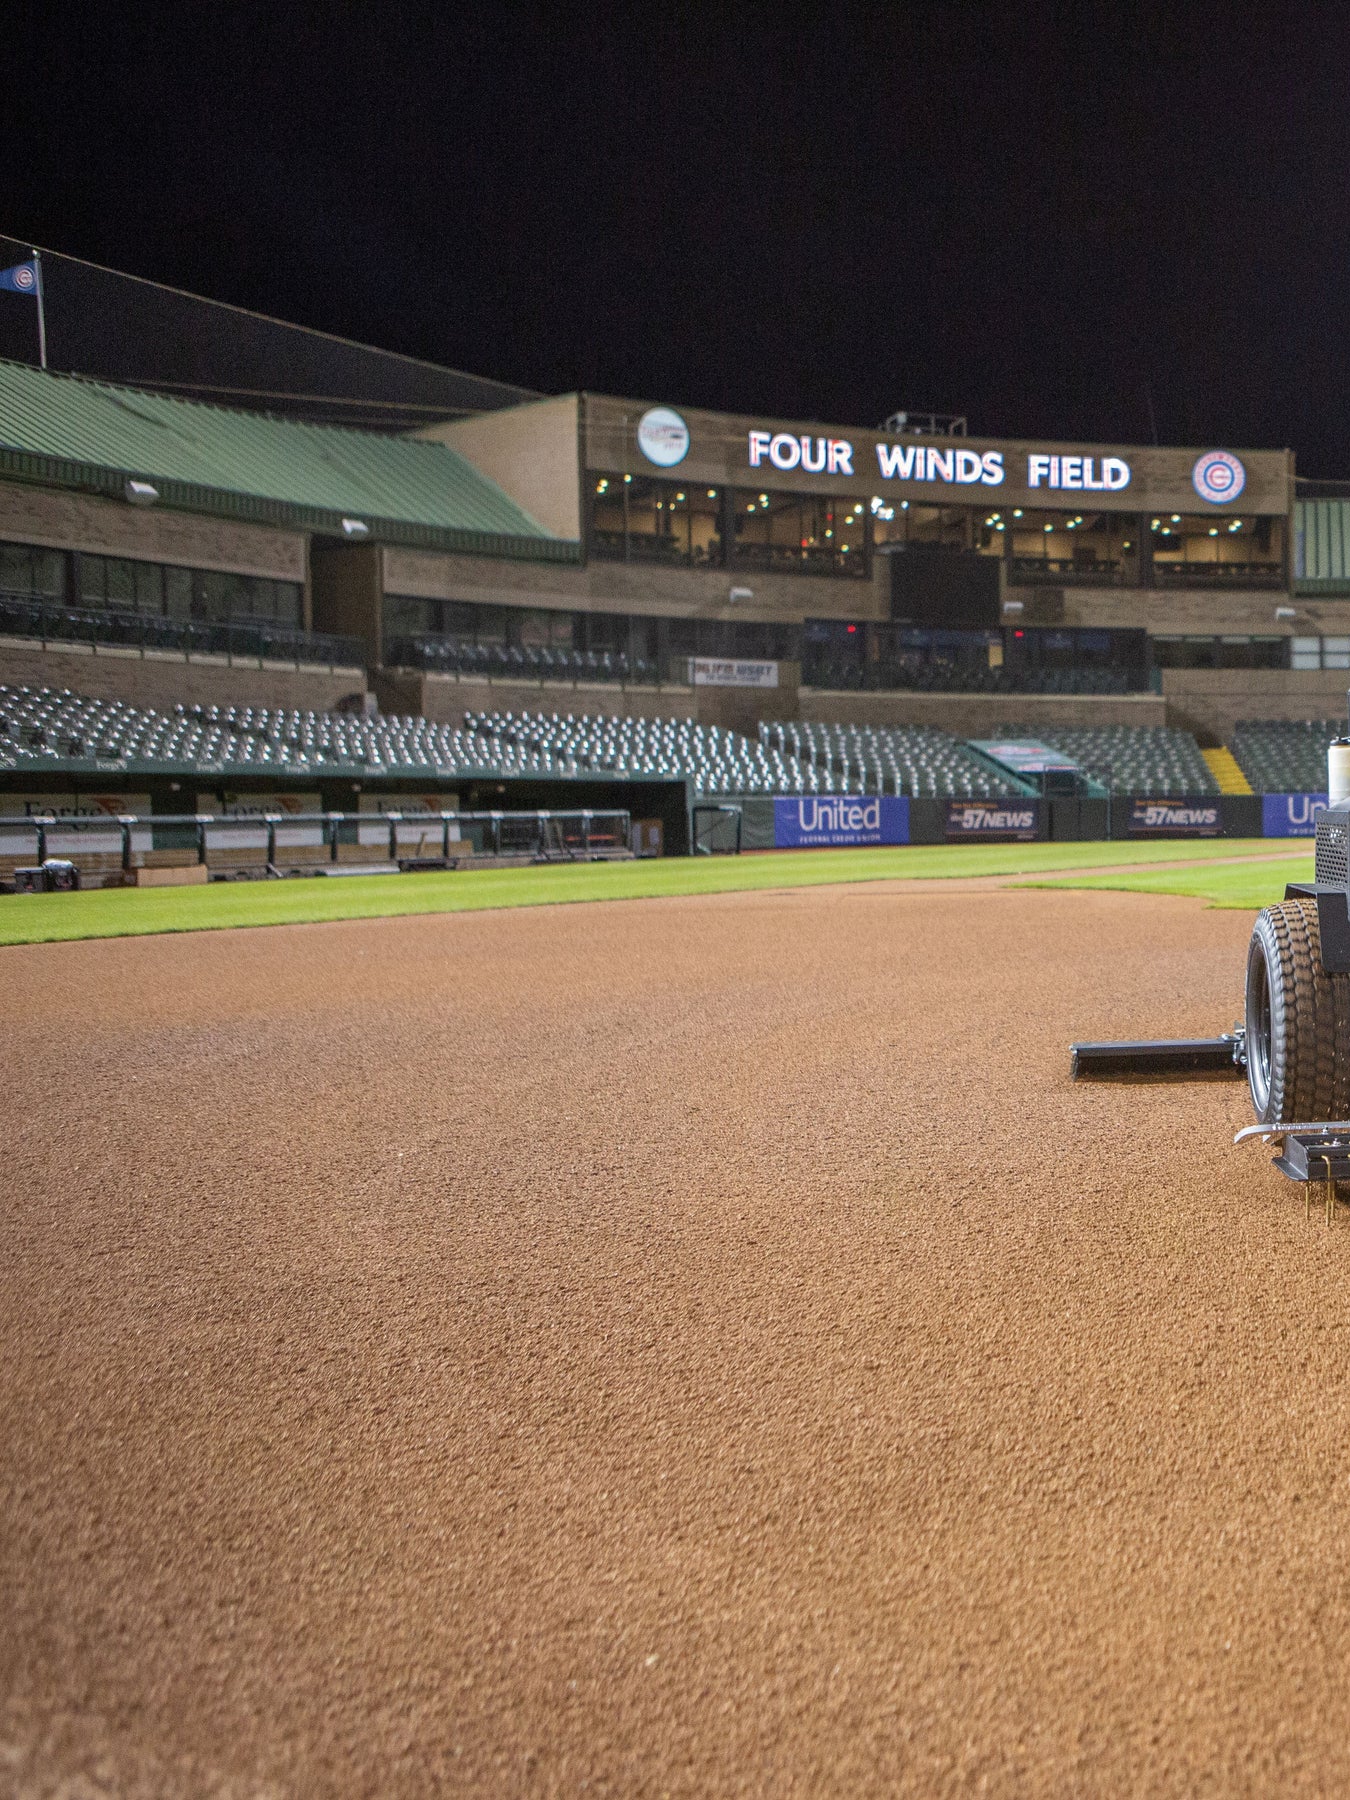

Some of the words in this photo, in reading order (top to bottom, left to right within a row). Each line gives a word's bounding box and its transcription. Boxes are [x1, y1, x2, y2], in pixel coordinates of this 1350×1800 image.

[749, 430, 854, 475] FOUR
[876, 443, 1005, 487] WINDS
[1028, 454, 1131, 491] FIELD
[798, 798, 880, 831] United
